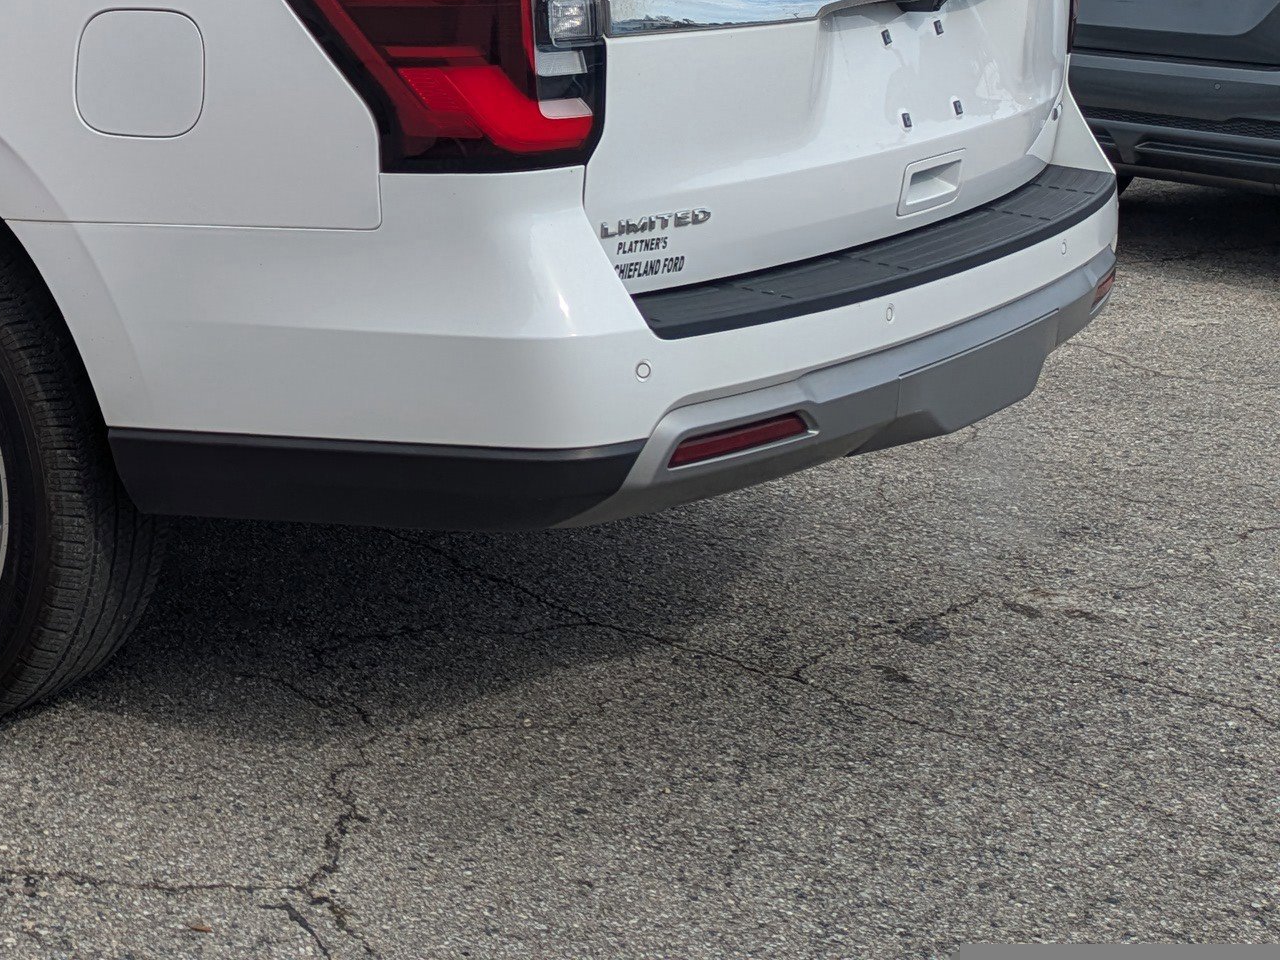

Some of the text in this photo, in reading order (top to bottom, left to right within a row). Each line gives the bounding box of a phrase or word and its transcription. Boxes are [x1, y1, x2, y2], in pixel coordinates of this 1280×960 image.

[600, 208, 711, 239] LIMITED
[616, 236, 668, 255] PLATTNER'S
[661, 256, 685, 274] FORD
